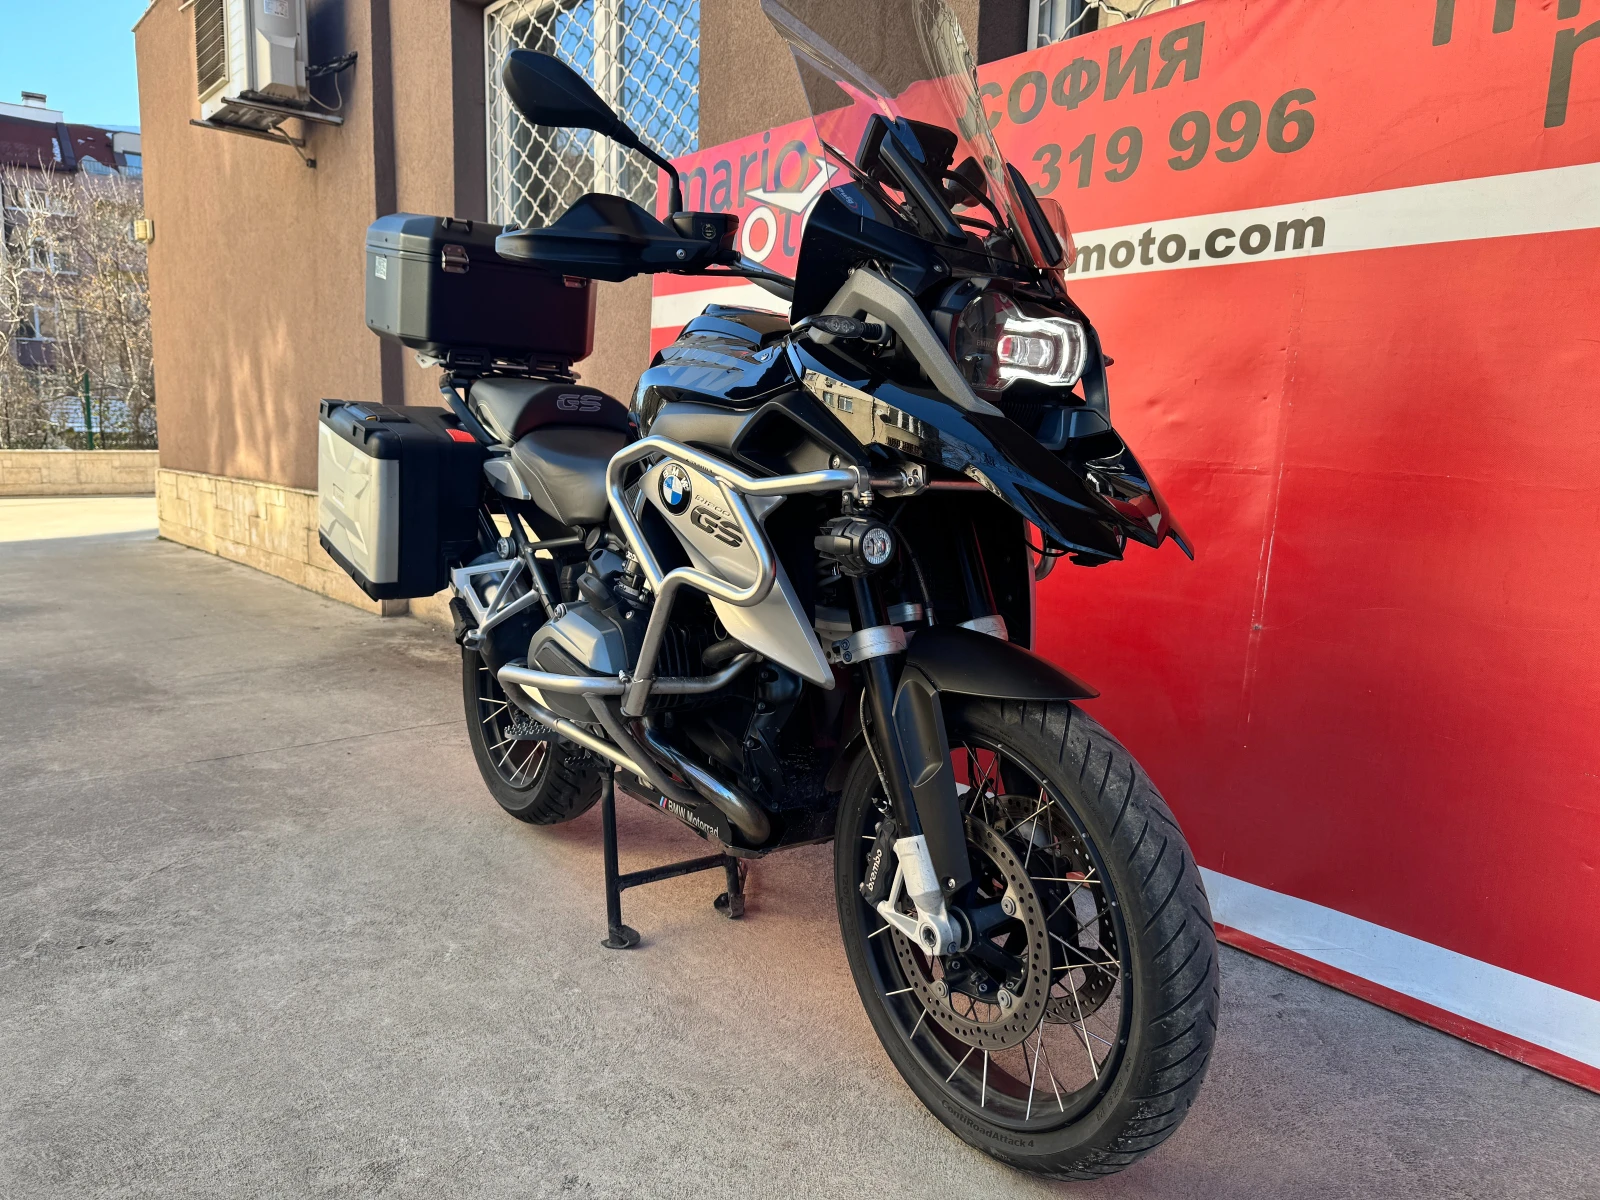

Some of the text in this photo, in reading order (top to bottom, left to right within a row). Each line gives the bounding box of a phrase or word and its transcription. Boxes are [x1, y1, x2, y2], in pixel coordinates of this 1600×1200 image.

[1029, 88, 1317, 197] 319 996
[556, 393, 603, 412] GS
[662, 465, 691, 492] BMW
[690, 505, 744, 549] GS
[667, 799, 719, 838] BMW Motorrad
[865, 848, 883, 892] brembo
[941, 1099, 1035, 1148] ContiRoadAttack 4
